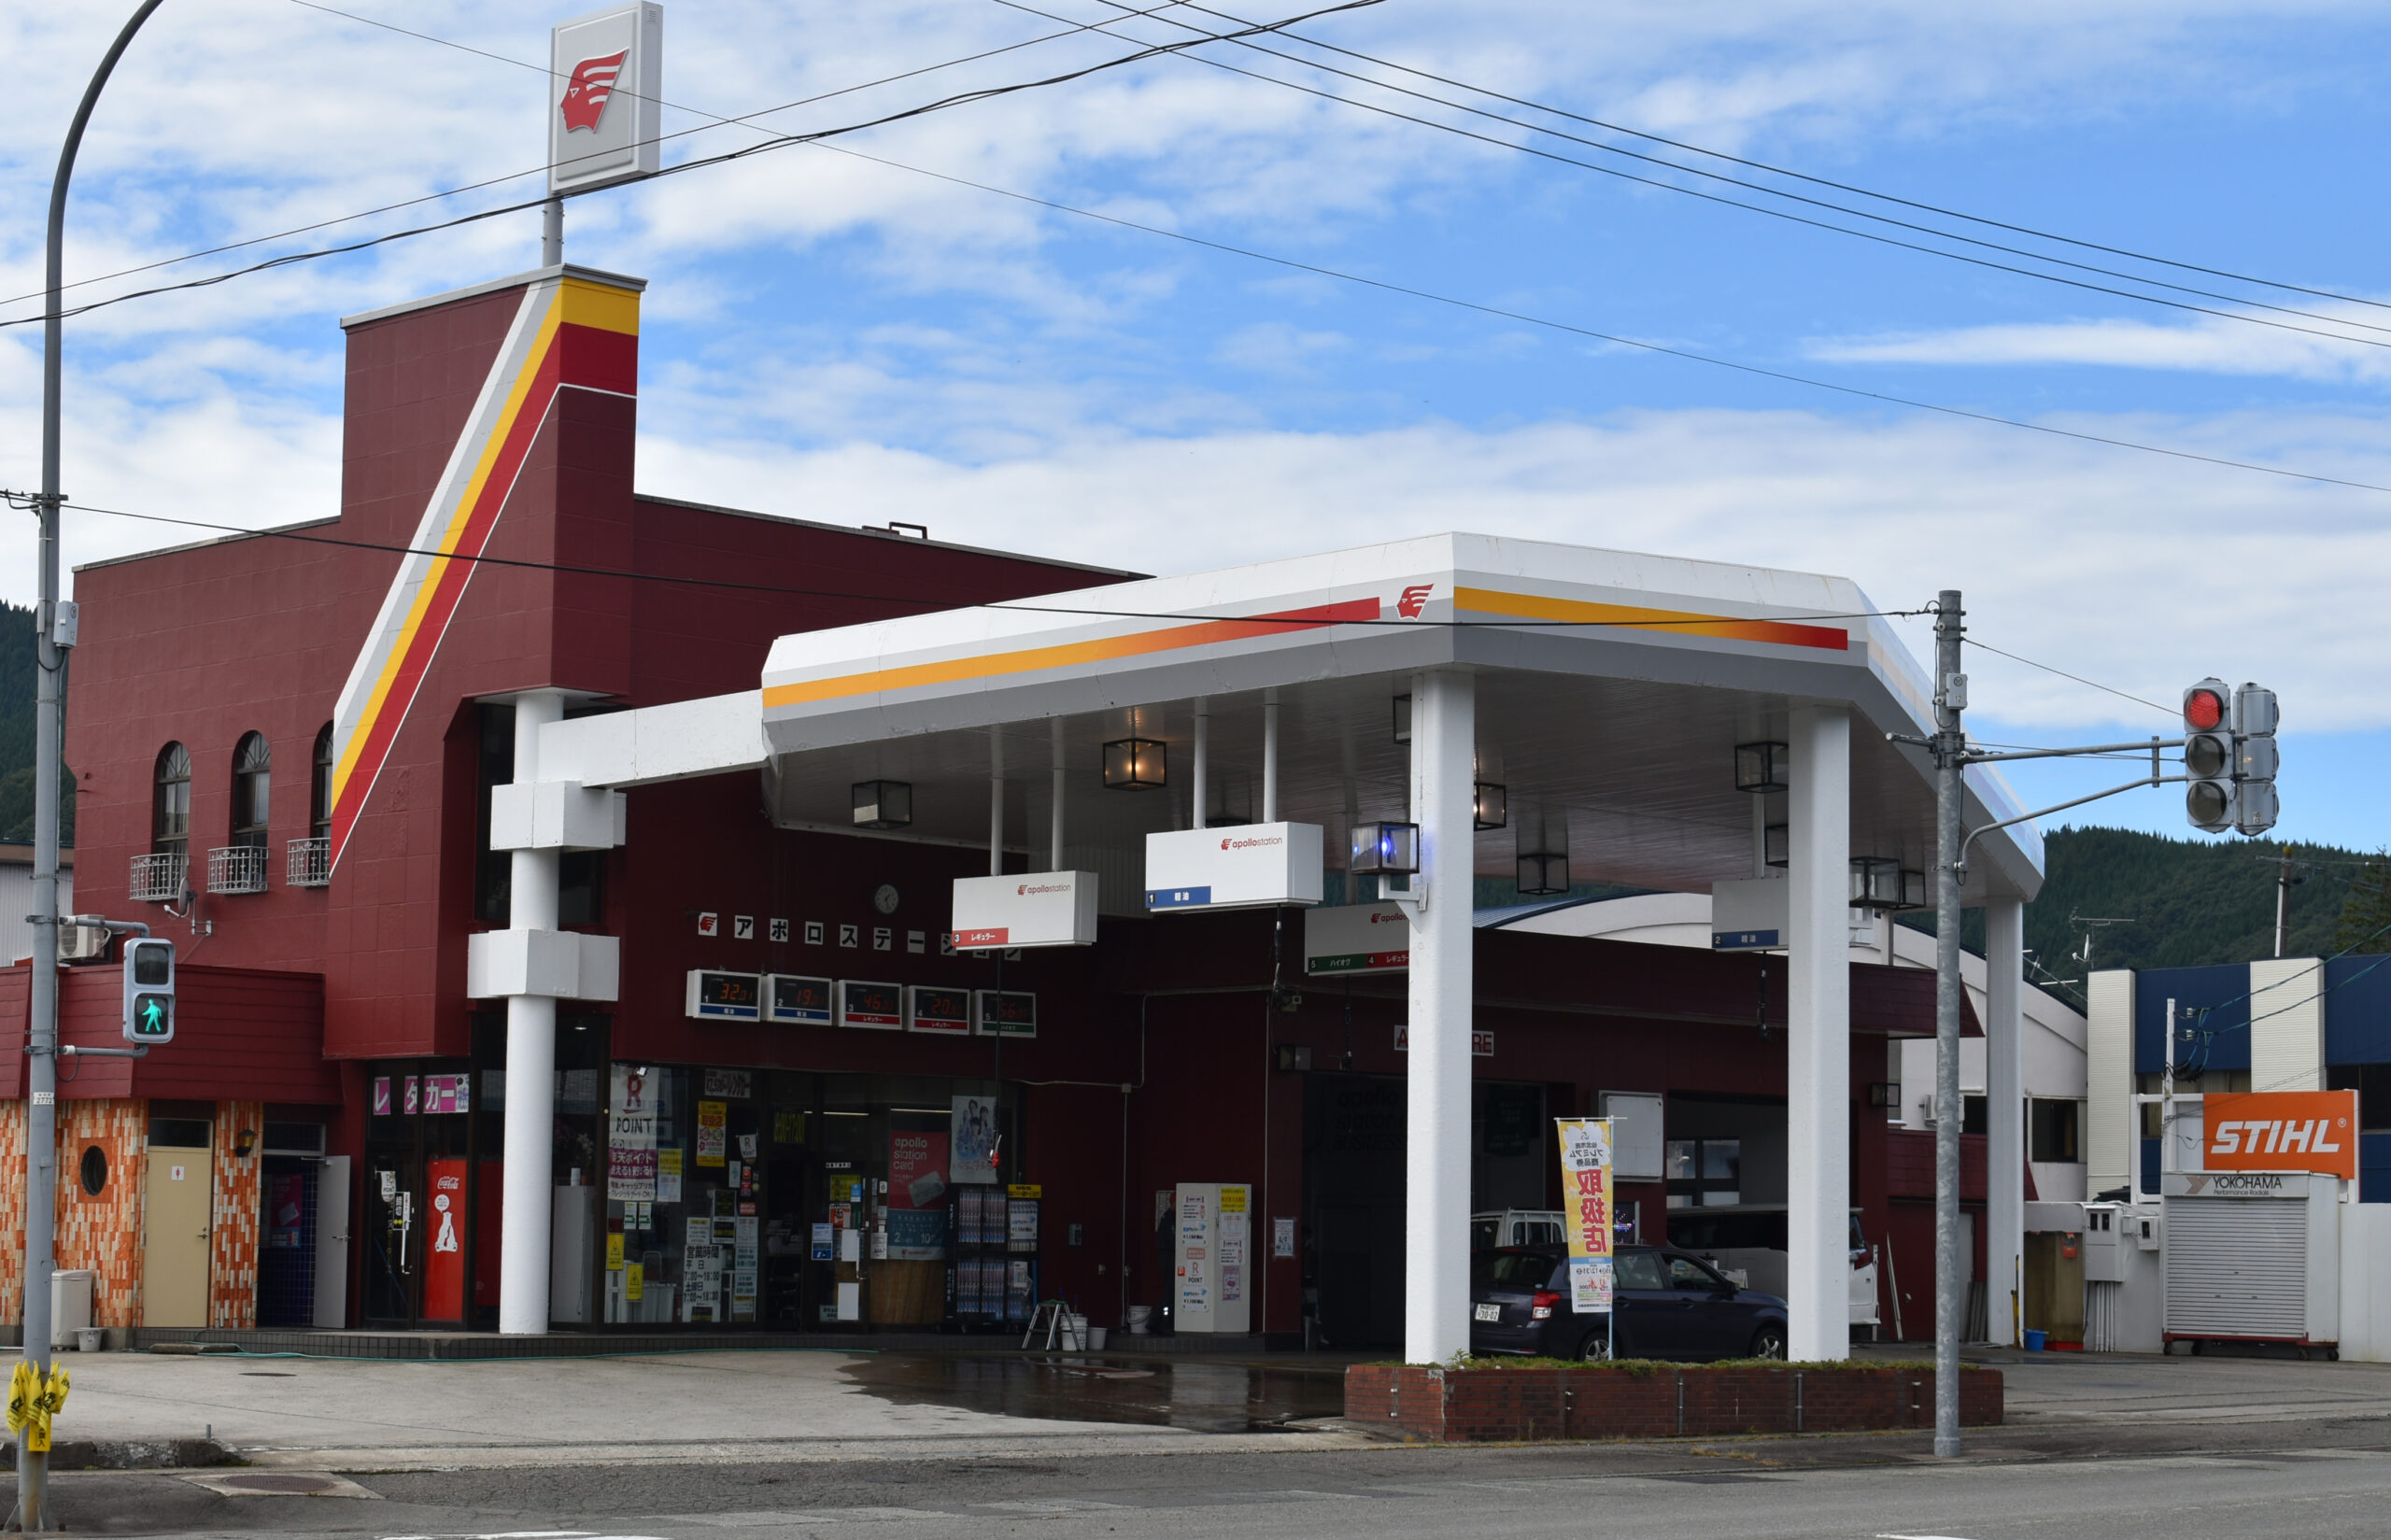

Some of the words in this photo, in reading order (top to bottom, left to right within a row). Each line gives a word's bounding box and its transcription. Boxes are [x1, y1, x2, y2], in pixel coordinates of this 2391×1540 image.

[1232, 836, 1283, 850] apollostation
[1027, 884, 1070, 896] apollostation
[955, 933, 961, 943] 3
[1715, 935, 1721, 944] 2
[1310, 959, 1317, 968] 5
[1330, 957, 1351, 968] ハイオク
[1368, 955, 1374, 965] 4
[616, 1118, 652, 1134] POINT
[2211, 1120, 2341, 1154] STIHL
[895, 1137, 927, 1151] apollo
[894, 1149, 927, 1161] station
[893, 1160, 913, 1171] card
[2213, 1176, 2283, 1189] YOKOHAMA
[686, 1245, 719, 1259] 営業時間
